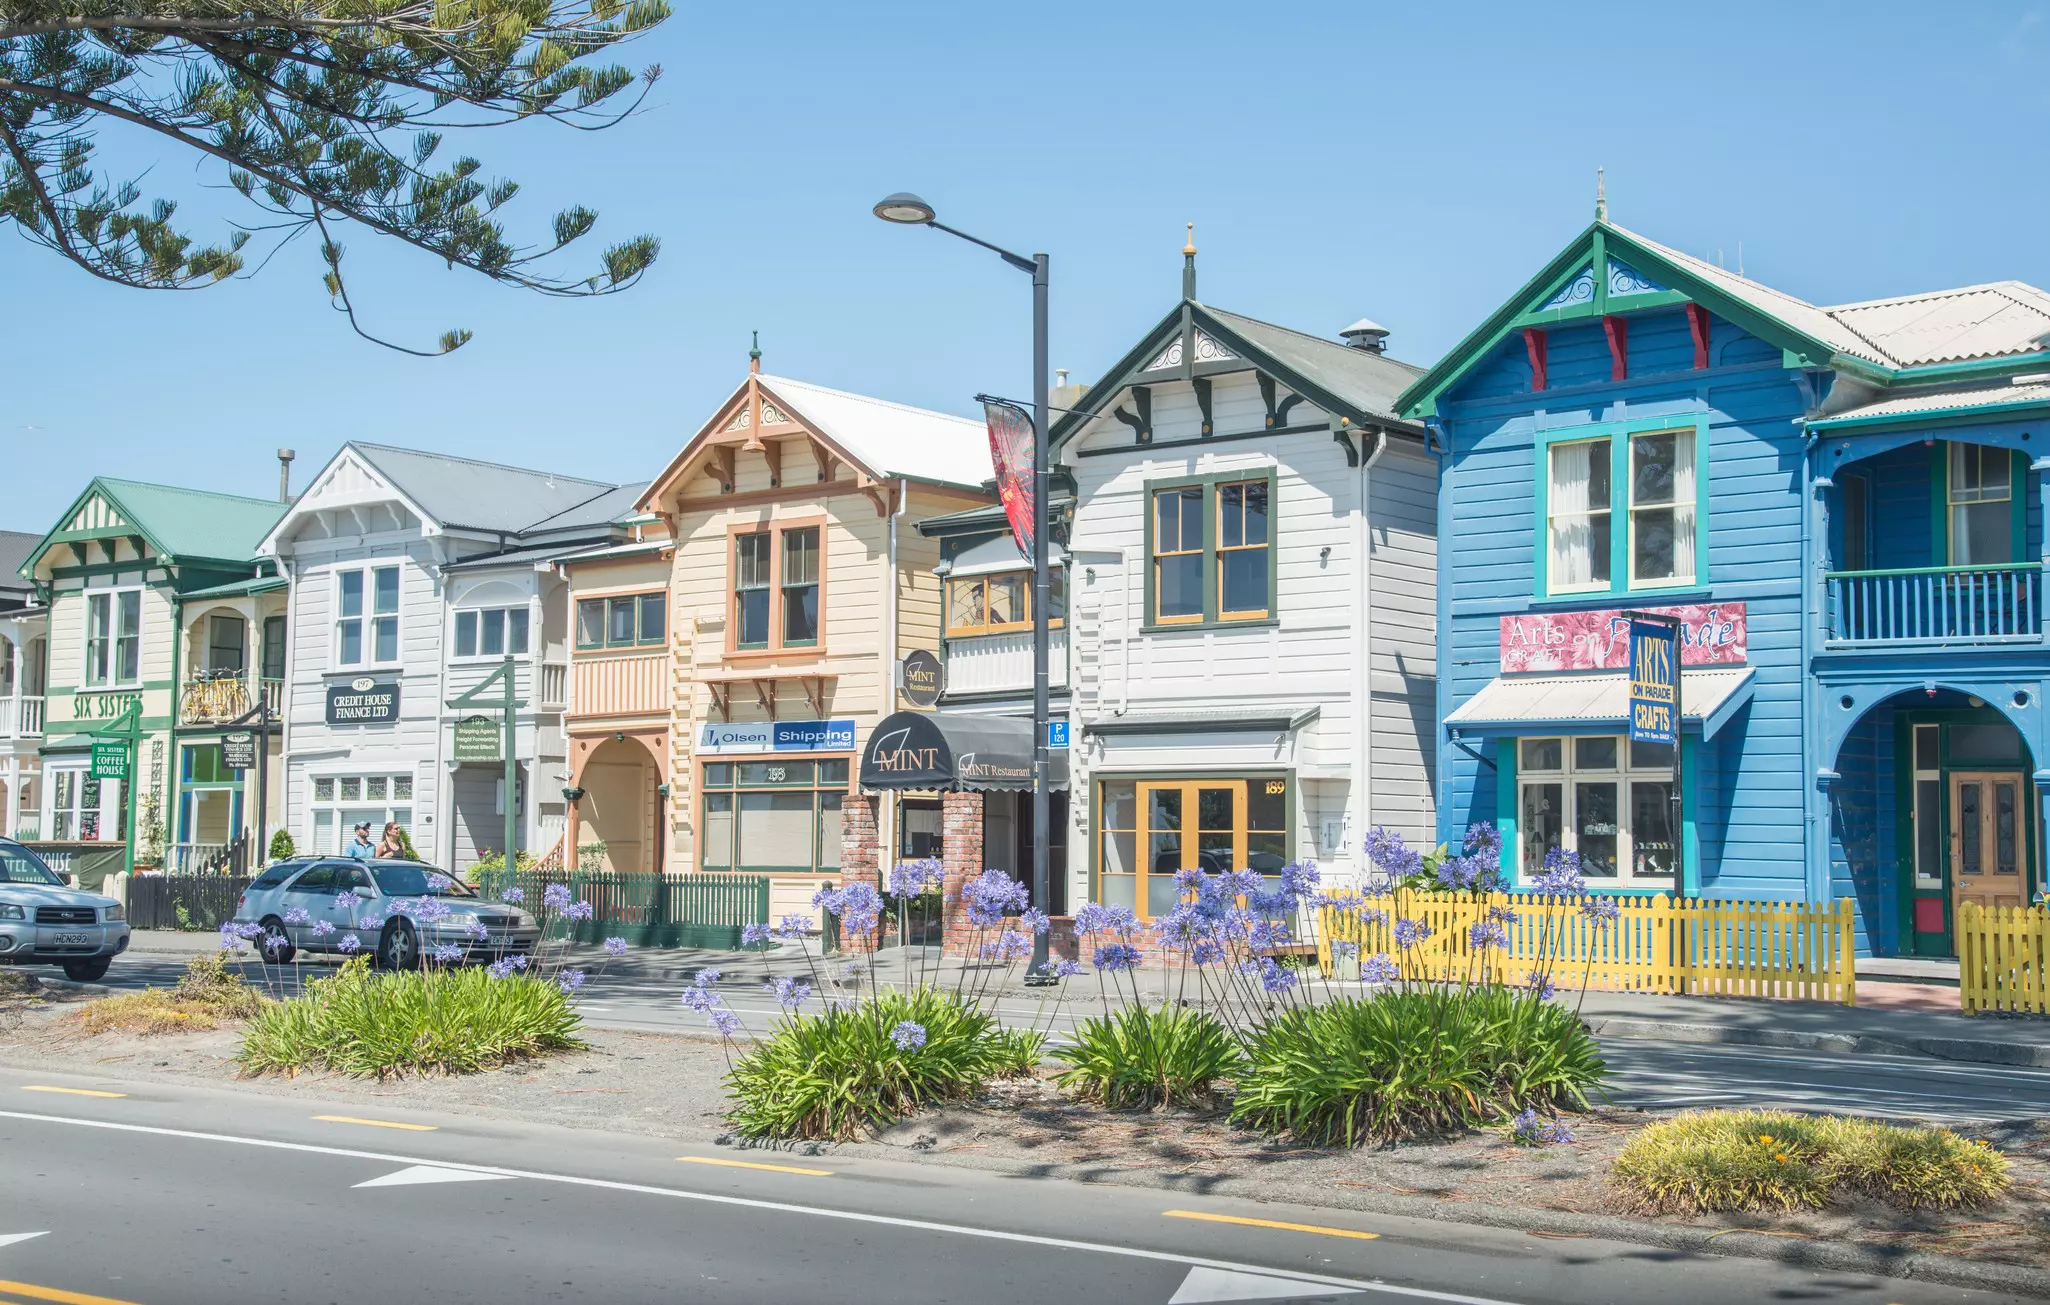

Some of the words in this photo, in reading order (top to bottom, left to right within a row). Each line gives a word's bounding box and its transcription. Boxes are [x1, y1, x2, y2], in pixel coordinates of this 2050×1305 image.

[1508, 620, 1565, 645] Arts
[1572, 632, 1600, 644] on
[1603, 609, 1736, 659] Pade
[1508, 648, 1564, 662] CRAFT
[1634, 636, 1670, 686] ARTS
[909, 671, 935, 682] MINT
[357, 680, 369, 688] 197
[909, 683, 935, 691] Restaurant
[1633, 684, 1643, 696] ON
[1645, 685, 1671, 699] PARADE
[73, 696, 92, 719] SIX
[97, 693, 143, 717] SISTE
[333, 695, 363, 707] CREDIT
[364, 694, 392, 706] HOUSE
[335, 707, 371, 719] FINANCE
[372, 706, 389, 717] LTD
[1635, 703, 1670, 731] CRAFTS
[1055, 724, 1063, 734] P
[722, 733, 767, 742] Olsen
[779, 730, 852, 742] Shipping
[1054, 734, 1065, 742] 120
[96, 756, 124, 765] COFFEE
[878, 748, 938, 772] MINT
[96, 765, 124, 775] HOUSE
[961, 763, 989, 777] MINT
[991, 764, 1031, 777] Restaurant
[1265, 781, 1285, 794] 189
[55, 934, 87, 944] HCN293
